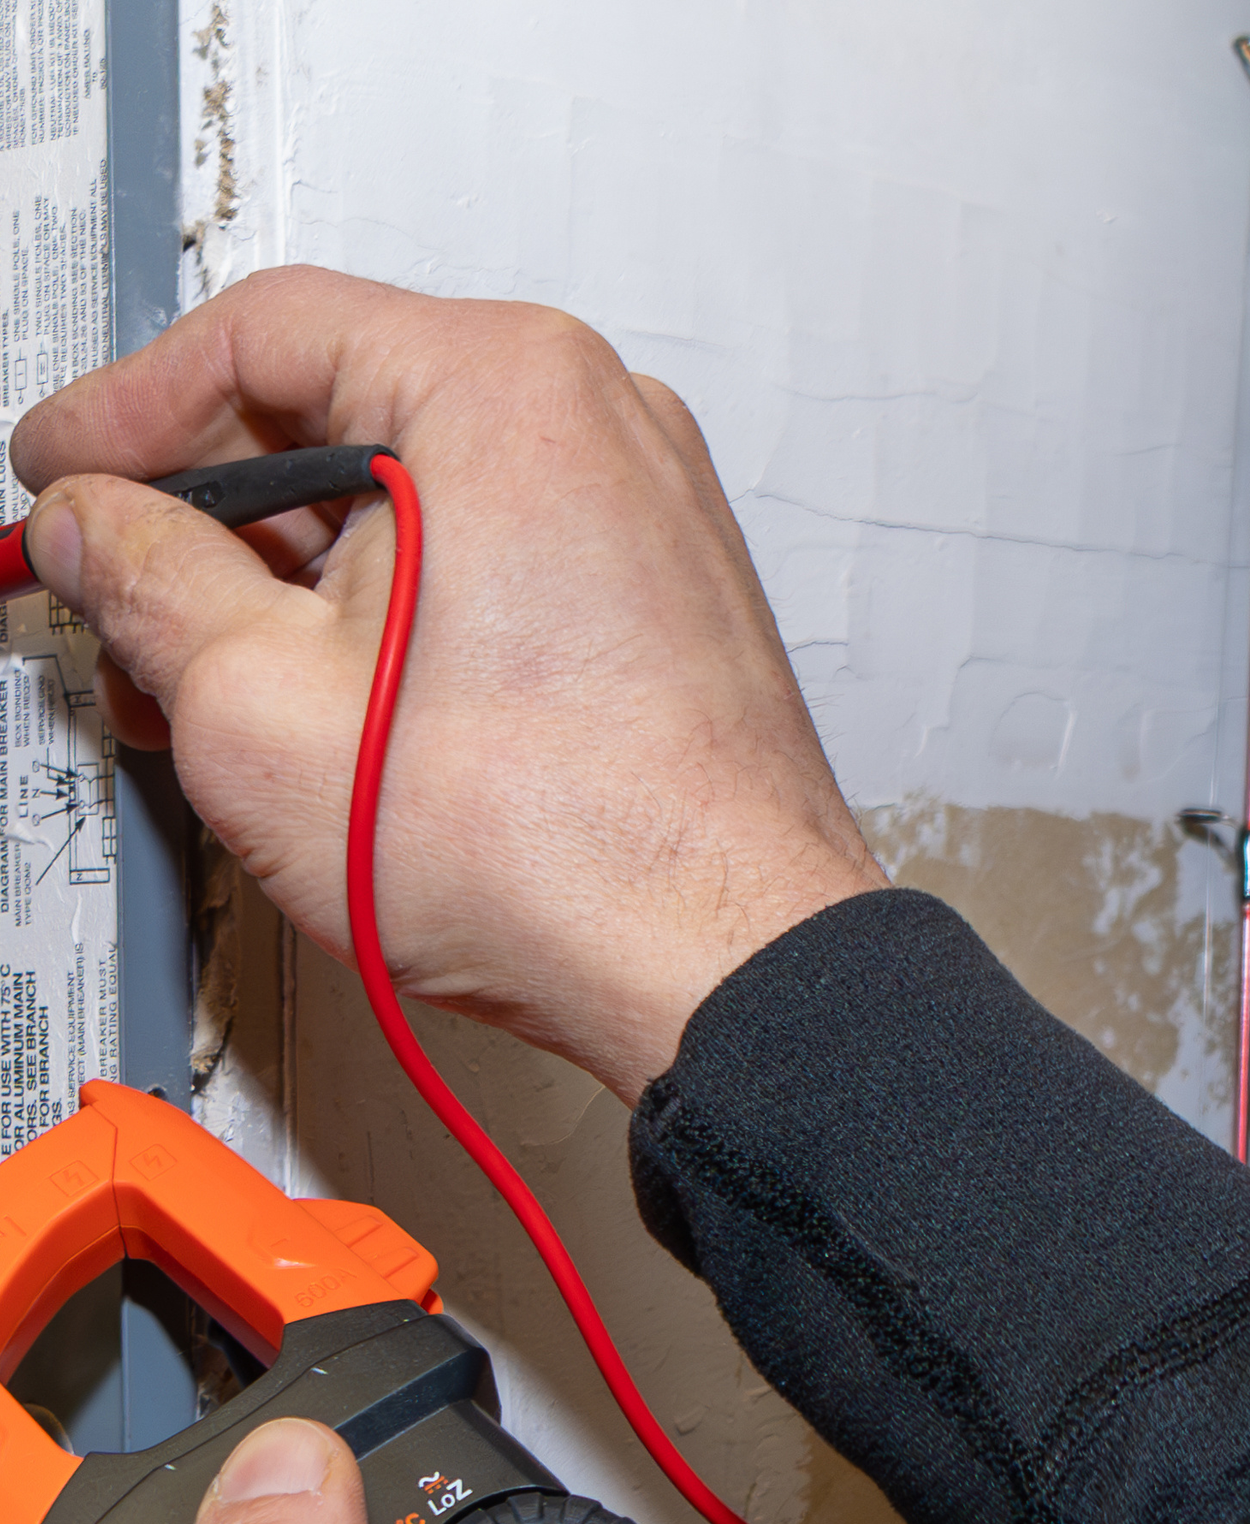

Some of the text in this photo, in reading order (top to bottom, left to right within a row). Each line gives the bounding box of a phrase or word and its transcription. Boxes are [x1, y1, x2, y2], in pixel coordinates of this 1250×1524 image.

[100, 191, 107, 206] BE
[43, 225, 50, 241] OR
[80, 265, 86, 279] OF
[22, 290, 28, 307] ON
[44, 284, 50, 302] ON
[91, 311, 98, 324] AS
[14, 669, 22, 721] BONDING
[0, 761, 8, 800] MAIN
[19, 775, 29, 818] LINE
[0, 839, 9, 913] DIAGRAM
[14, 843, 22, 897] BREAKER
[26, 971, 36, 1050] BRANCH
[67, 971, 75, 1042] EQUIPMENT
[75, 943, 86, 1056] (MAIN BREAKER) IS
[1, 1011, 10, 1056] WITH
[13, 973, 24, 1120] ALUMINUM MAIN
[99, 1006, 108, 1077] BREAKER
[109, 1001, 117, 1058] RATING
[1, 1061, 10, 1097] USE
[27, 1055, 36, 1091] SEE
[39, 1006, 49, 1127] FOR BRANCH
[1, 1102, 11, 1139] FOR
[294, 1268, 357, 1308] 600A
[427, 1478, 473, 1516] LoZ
